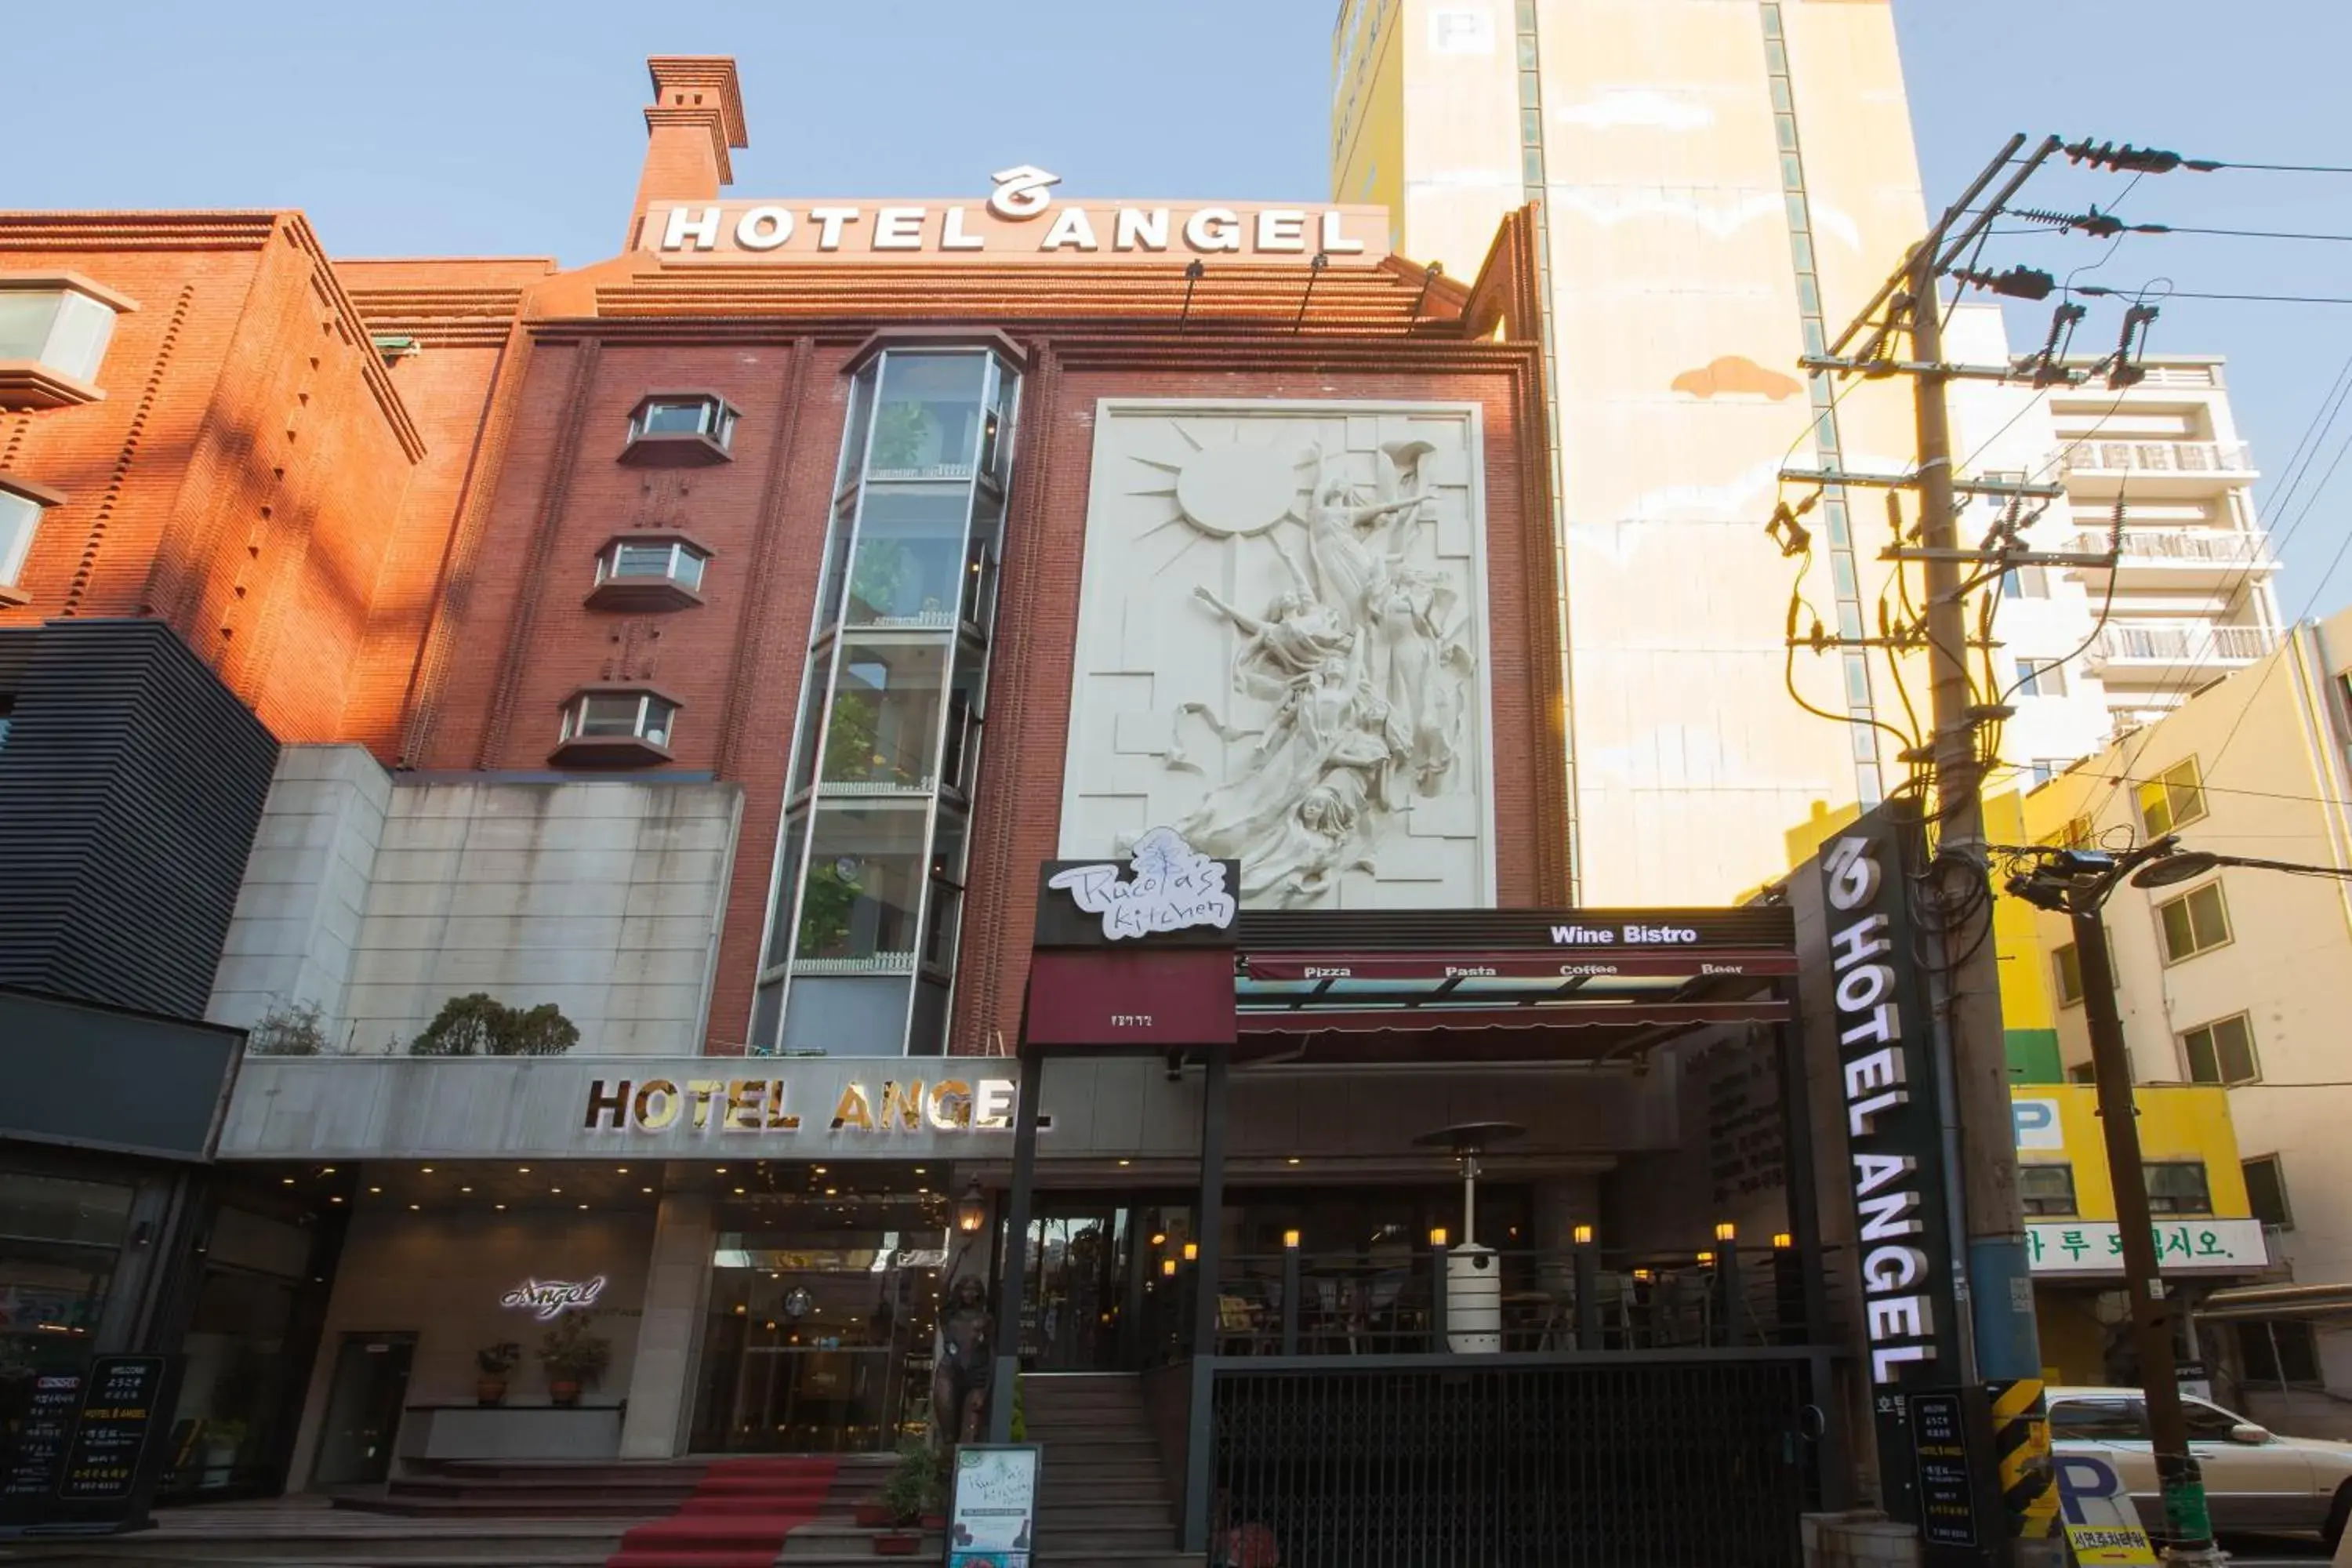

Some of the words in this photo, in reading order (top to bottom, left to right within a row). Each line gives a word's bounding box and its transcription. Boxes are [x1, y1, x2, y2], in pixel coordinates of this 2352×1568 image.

[661, 205, 985, 252] HOTEL
[1041, 206, 1365, 254] ANGEL
[1551, 926, 1613, 944] Wine
[1623, 925, 1697, 943] Bistro
[1304, 966, 1351, 978] Pizza
[1445, 966, 1497, 977] Pasta
[1560, 964, 1618, 975] Coffee
[1701, 964, 1742, 975] Beer
[1831, 913, 1908, 1137] HOTEL
[584, 1080, 800, 1129] HOTEL
[829, 1079, 1051, 1130] ANGE
[1853, 1154, 1936, 1384] ANGEL
[499, 1276, 607, 1320] Angel
[2050, 1456, 2118, 1524] P
